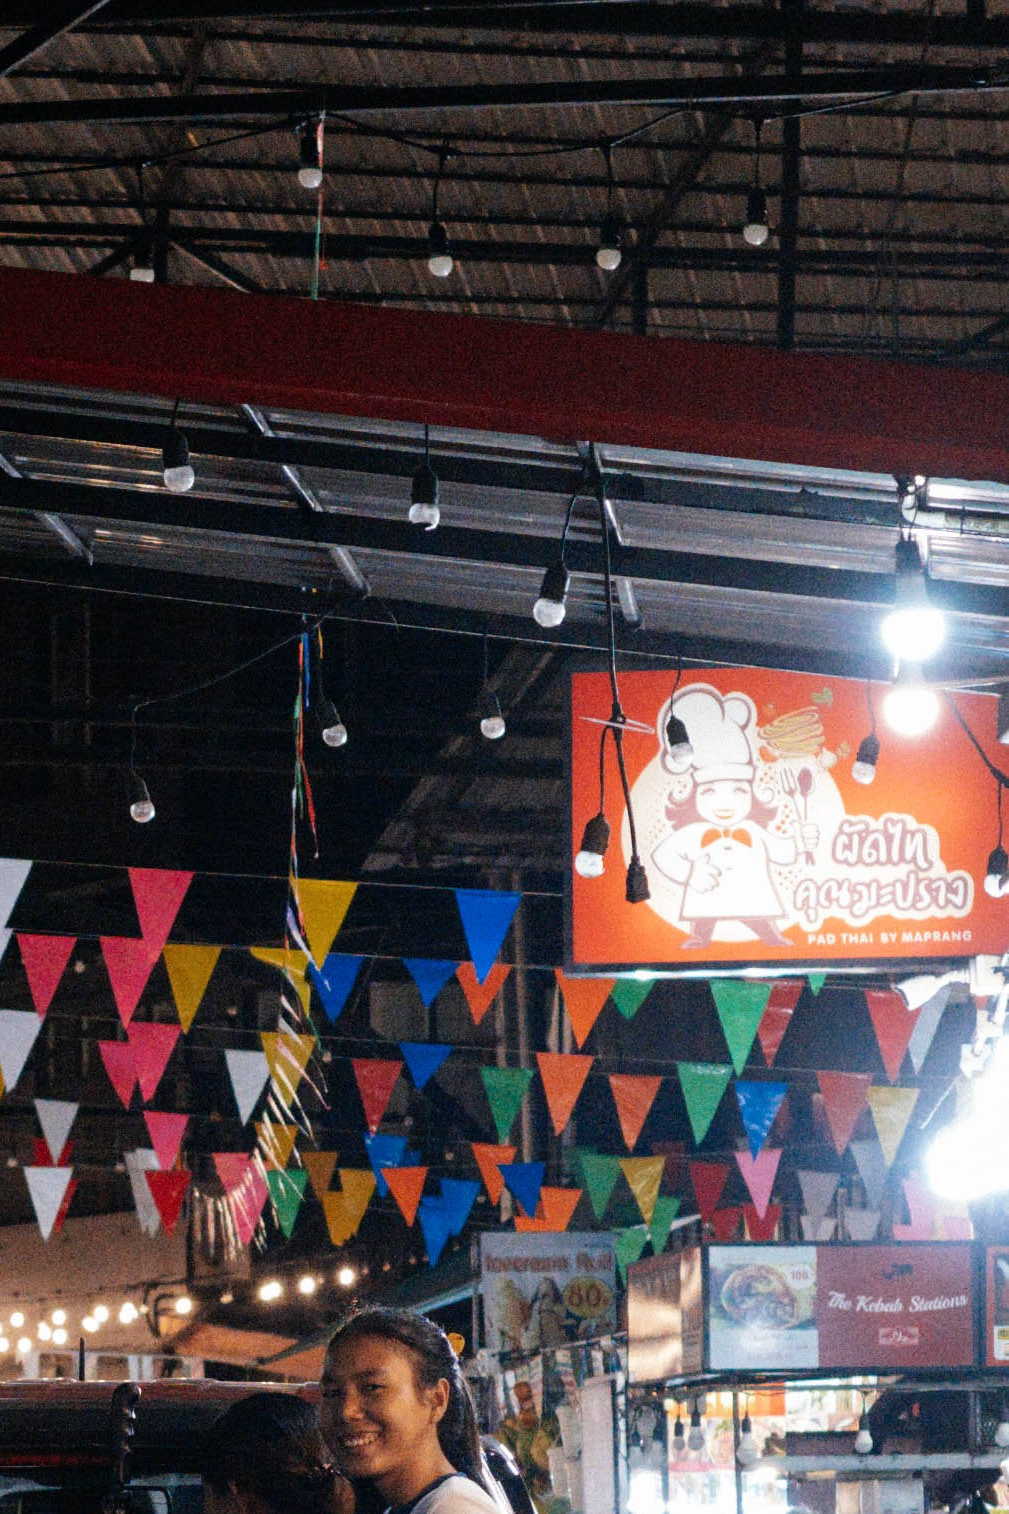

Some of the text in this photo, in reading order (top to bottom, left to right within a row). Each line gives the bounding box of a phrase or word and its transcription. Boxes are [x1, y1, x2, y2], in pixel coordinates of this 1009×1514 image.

[832, 819, 934, 870] ผัดไท
[807, 930, 972, 945] PAD THAI BY MAPRANG
[828, 1290, 968, 1313] The Kebab Stations
